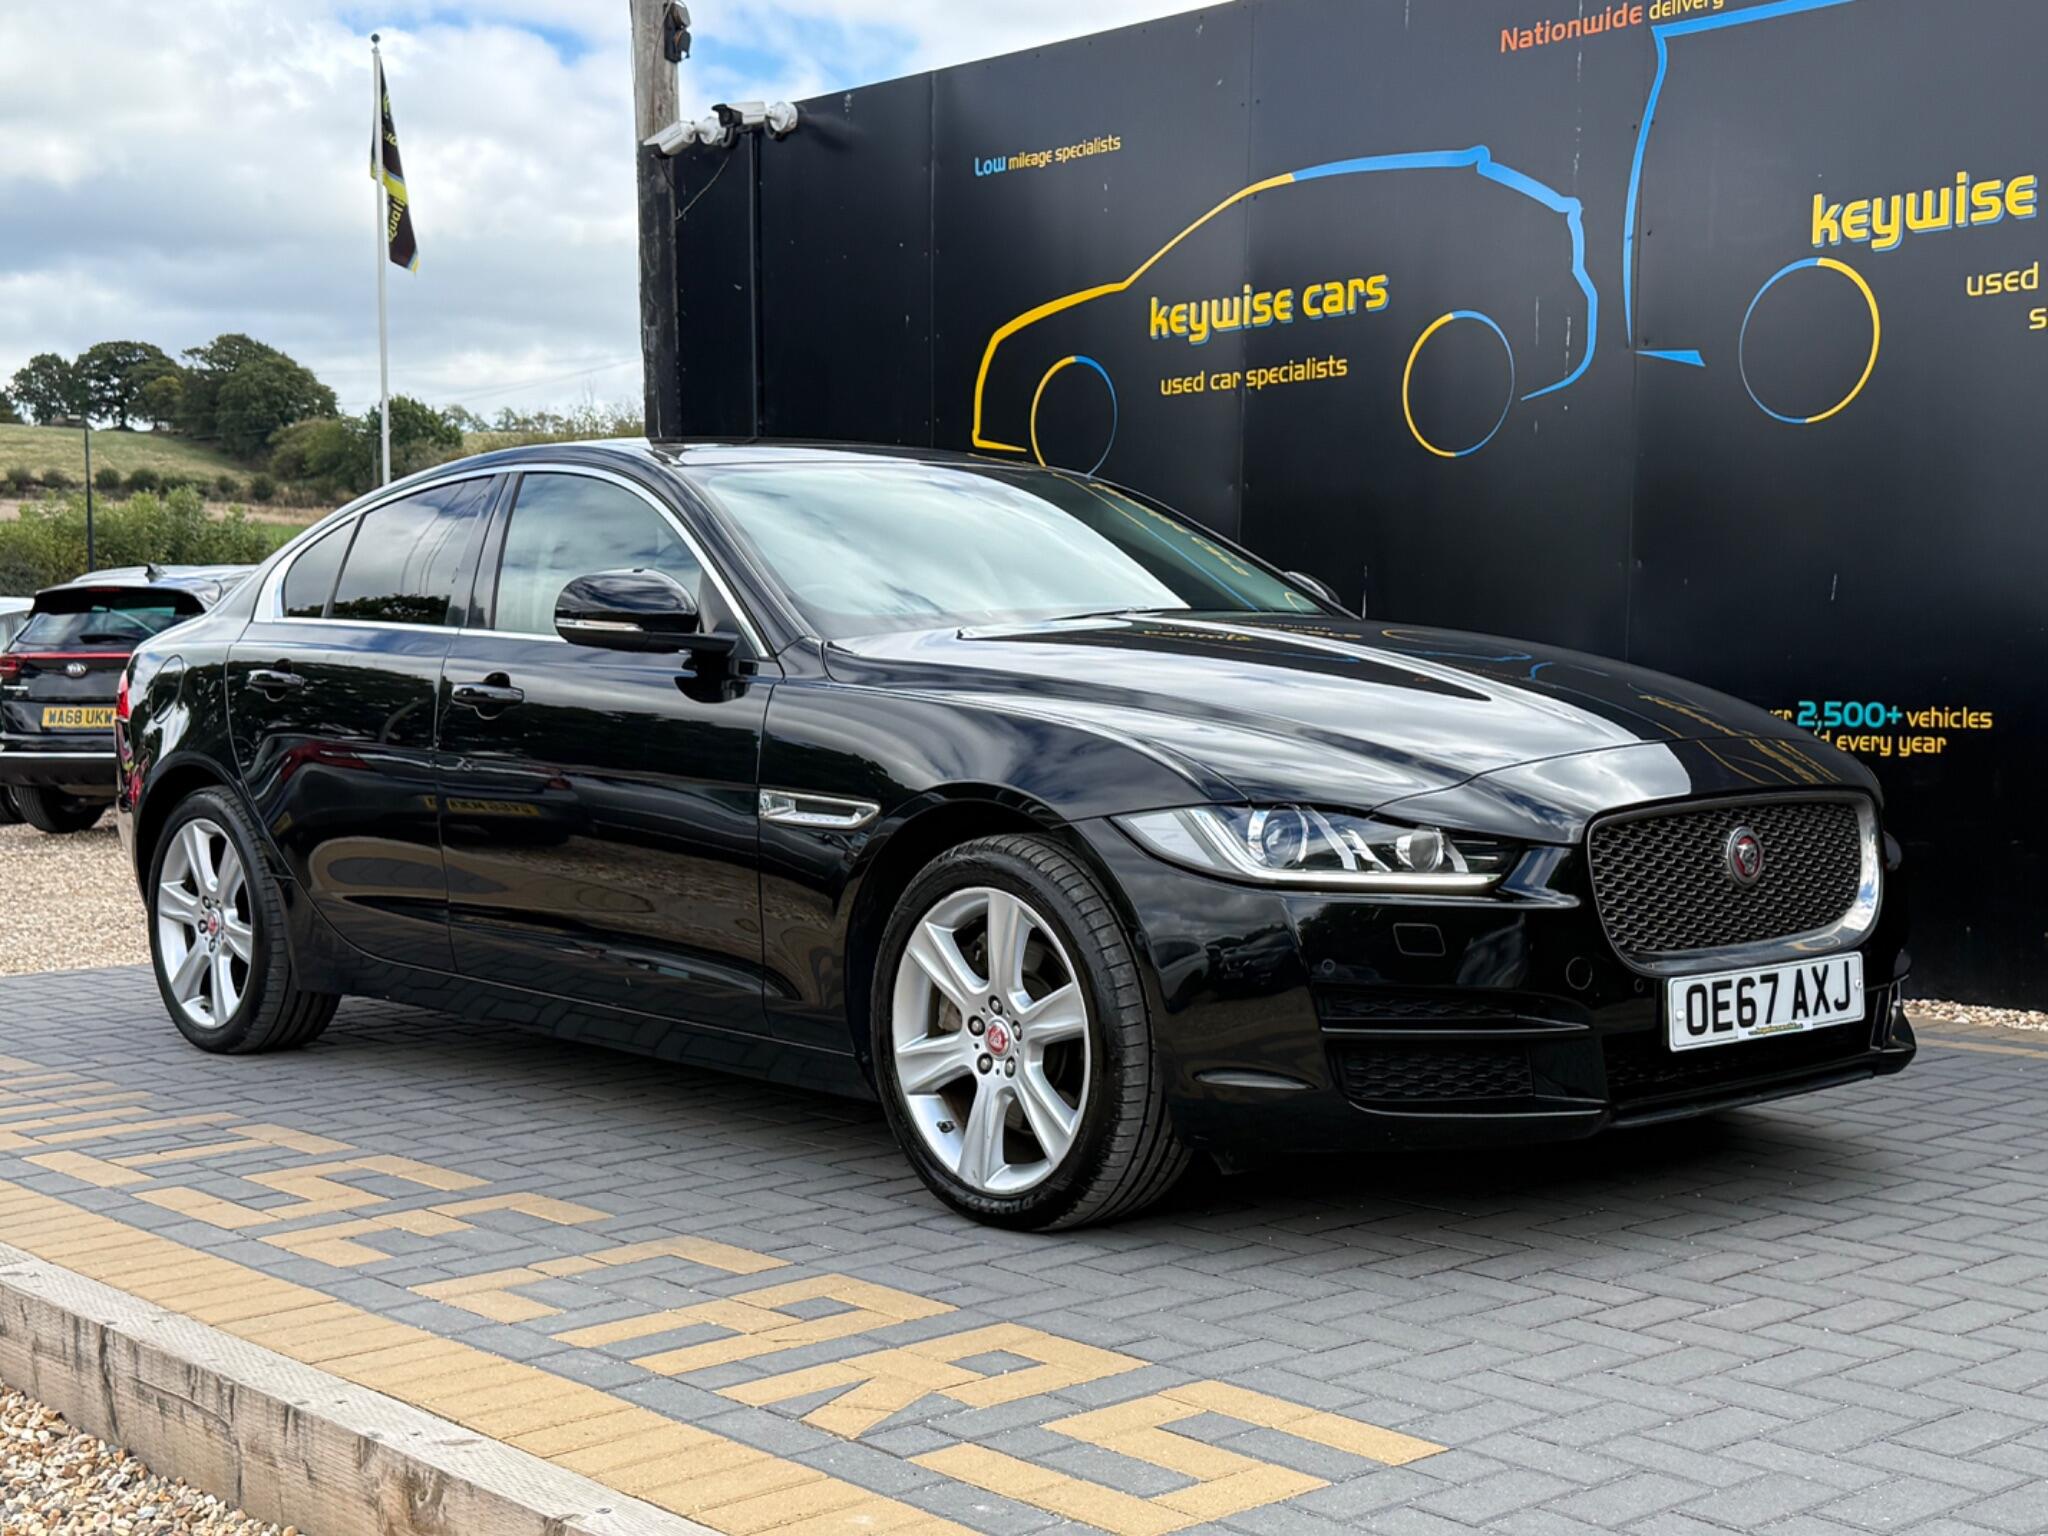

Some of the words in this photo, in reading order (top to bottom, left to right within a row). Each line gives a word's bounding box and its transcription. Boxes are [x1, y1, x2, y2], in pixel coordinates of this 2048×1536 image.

[1500, 3, 1643, 53] Nationwide
[974, 156, 1007, 177] Low
[1008, 150, 1053, 169] mileage
[1055, 134, 1121, 163] specialists
[1812, 171, 2037, 251] keywise
[1965, 261, 2039, 296] used
[1150, 284, 1293, 345] keywise
[1303, 274, 1390, 321] cars
[1161, 371, 1205, 395] used
[1210, 372, 1242, 391] car
[1246, 355, 1348, 390] specialists
[1797, 701, 1903, 731] 2,500+
[1906, 706, 1993, 729] vehicles
[1836, 735, 1891, 757] every
[1899, 734, 1948, 757] year
[1686, 974, 1780, 1036] OE67
[1792, 961, 1851, 1020] AXJ
